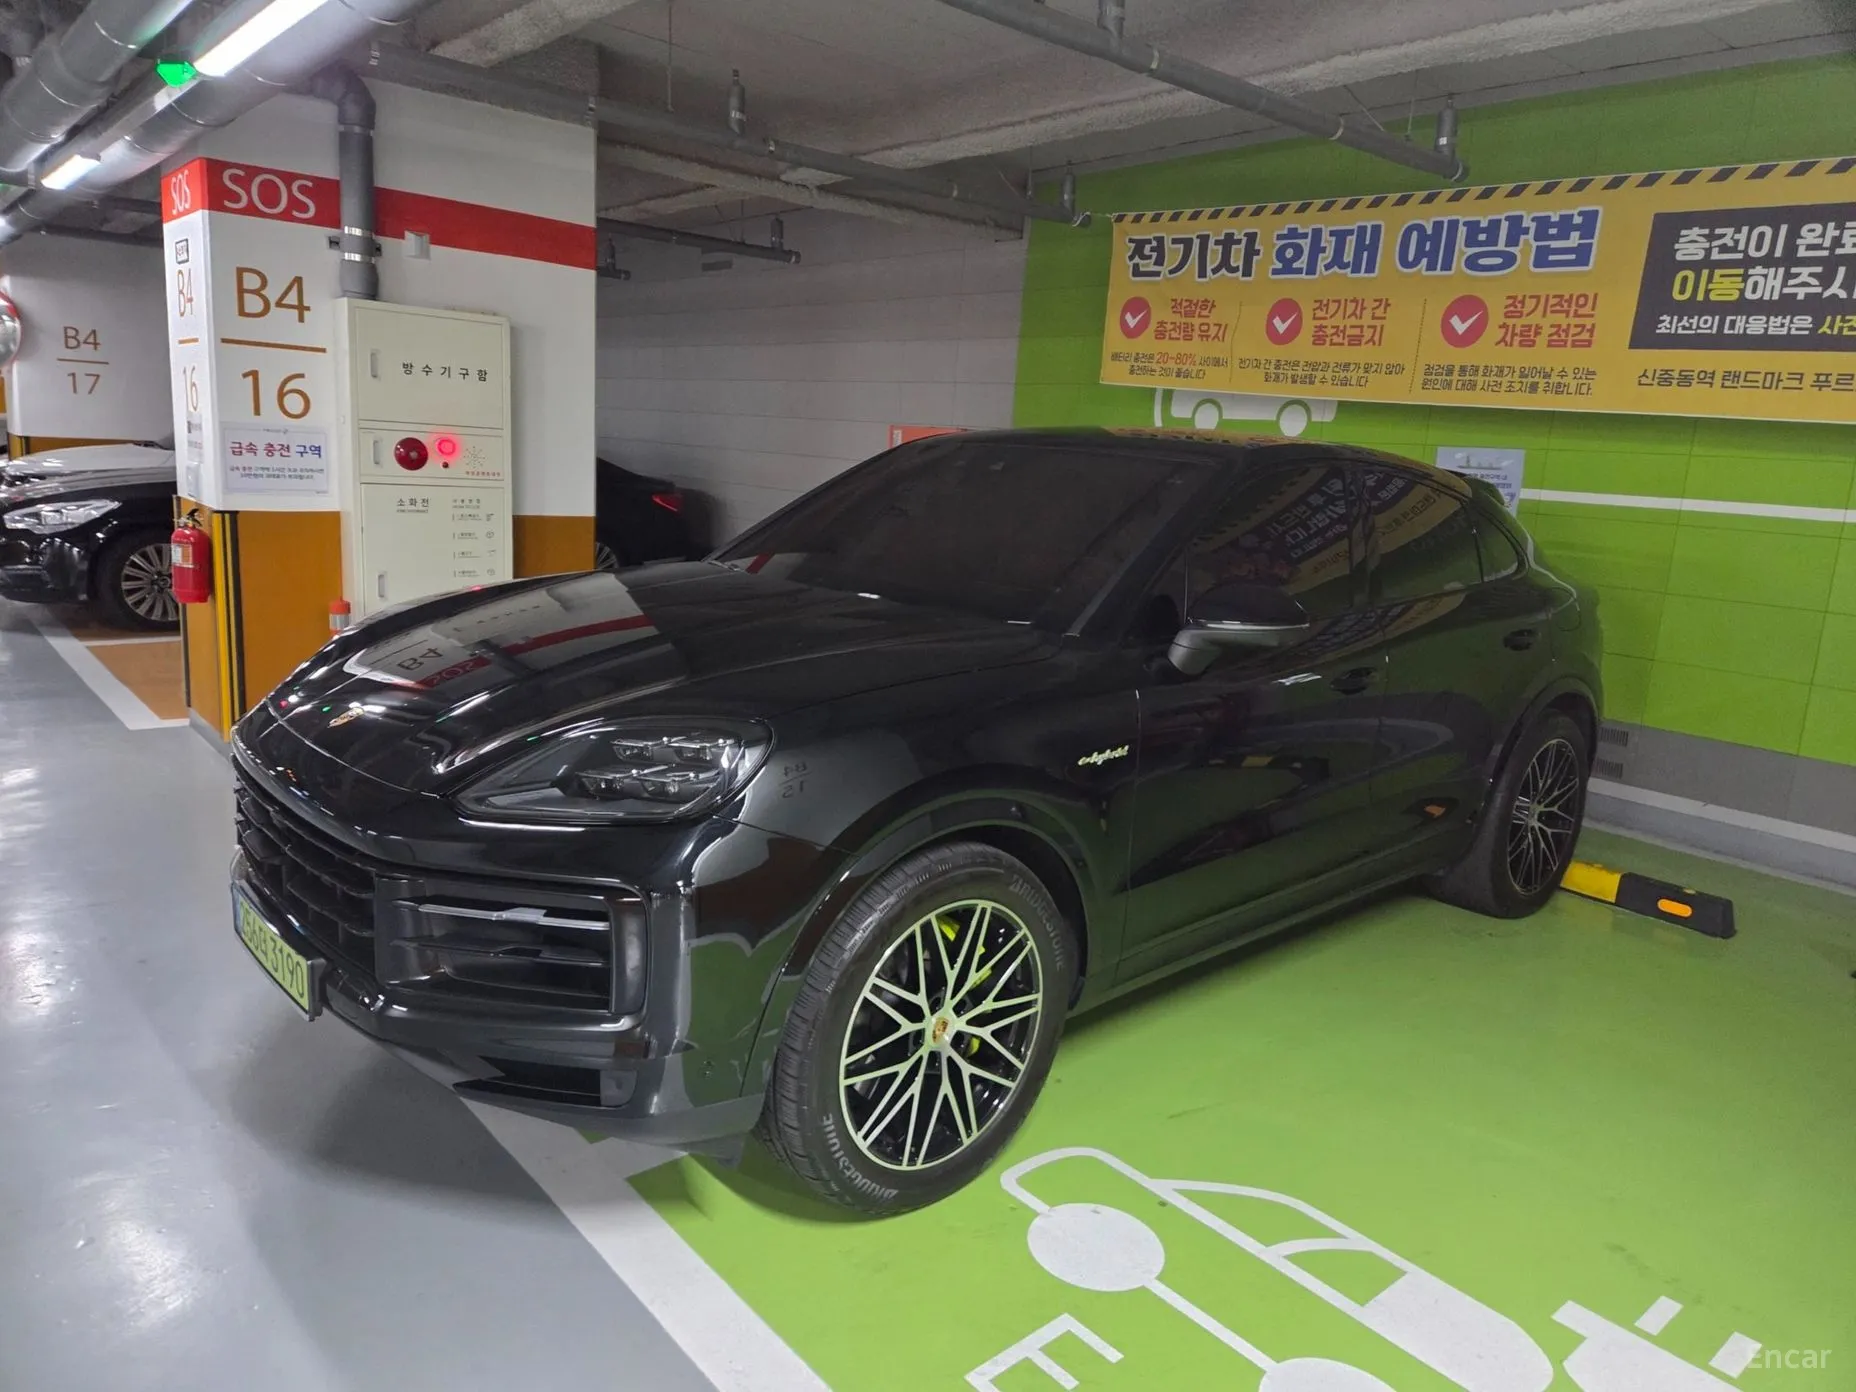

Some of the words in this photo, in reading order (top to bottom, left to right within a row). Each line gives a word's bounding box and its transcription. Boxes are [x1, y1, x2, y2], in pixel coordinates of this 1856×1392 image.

[171, 169, 191, 215] SOS
[222, 168, 316, 219] SOS
[1126, 231, 1261, 279] 전기차
[1270, 223, 1384, 277] 화재
[1397, 207, 1601, 275] 예방법
[1674, 224, 1789, 261] 충전이
[177, 266, 194, 318] B4
[235, 266, 311, 323] B4
[1169, 298, 1216, 319] 적절한
[1311, 297, 1367, 321] 전기차
[1371, 297, 1391, 321] 간
[1503, 293, 1598, 320] 정기적인
[1153, 320, 1195, 342] 충전량
[1198, 321, 1228, 343] 유지
[1310, 324, 1385, 347] 충전금지
[1494, 322, 1543, 349] 차량
[1547, 322, 1596, 349] 점검
[1655, 314, 1720, 335] 최선의
[1723, 315, 1813, 335] 대응법은
[63, 327, 101, 351] B4
[1128, 364, 1157, 376] 충전하는
[1158, 365, 1174, 377] 것이
[1175, 367, 1206, 380] 좋습니다
[1238, 357, 1262, 370] 전기차
[1263, 358, 1273, 370] 간
[1273, 359, 1301, 372] 충전은
[1302, 360, 1331, 374] 전압과
[1331, 361, 1362, 374] 전류가
[1362, 363, 1384, 375] 맞지
[1423, 363, 1455, 377] 점검을
[1457, 364, 1480, 378] 통해
[1481, 365, 1517, 379] 화재가
[1518, 365, 1555, 380] 일어날
[1556, 367, 1569, 380] 수
[1571, 367, 1597, 381] 있는
[67, 372, 101, 395] 17
[182, 365, 199, 412] 16
[1263, 372, 1289, 384] 화재가
[1290, 373, 1318, 386] 발생할
[1318, 375, 1329, 386] 수
[1330, 375, 1369, 388] 있습니다
[1421, 378, 1453, 391] 원인에
[1455, 379, 1478, 392] 대해
[1480, 380, 1502, 393] 사전
[1504, 381, 1540, 395] 조치를
[1637, 368, 1716, 388] 신중동역
[1720, 369, 1805, 391] 랜드마크
[1810, 372, 1856, 392] 푸르
[241, 369, 311, 420] 16
[229, 441, 258, 457] 급속
[263, 442, 291, 458] 충전
[295, 444, 322, 459] 구역
[269, 936, 305, 998] 3190
